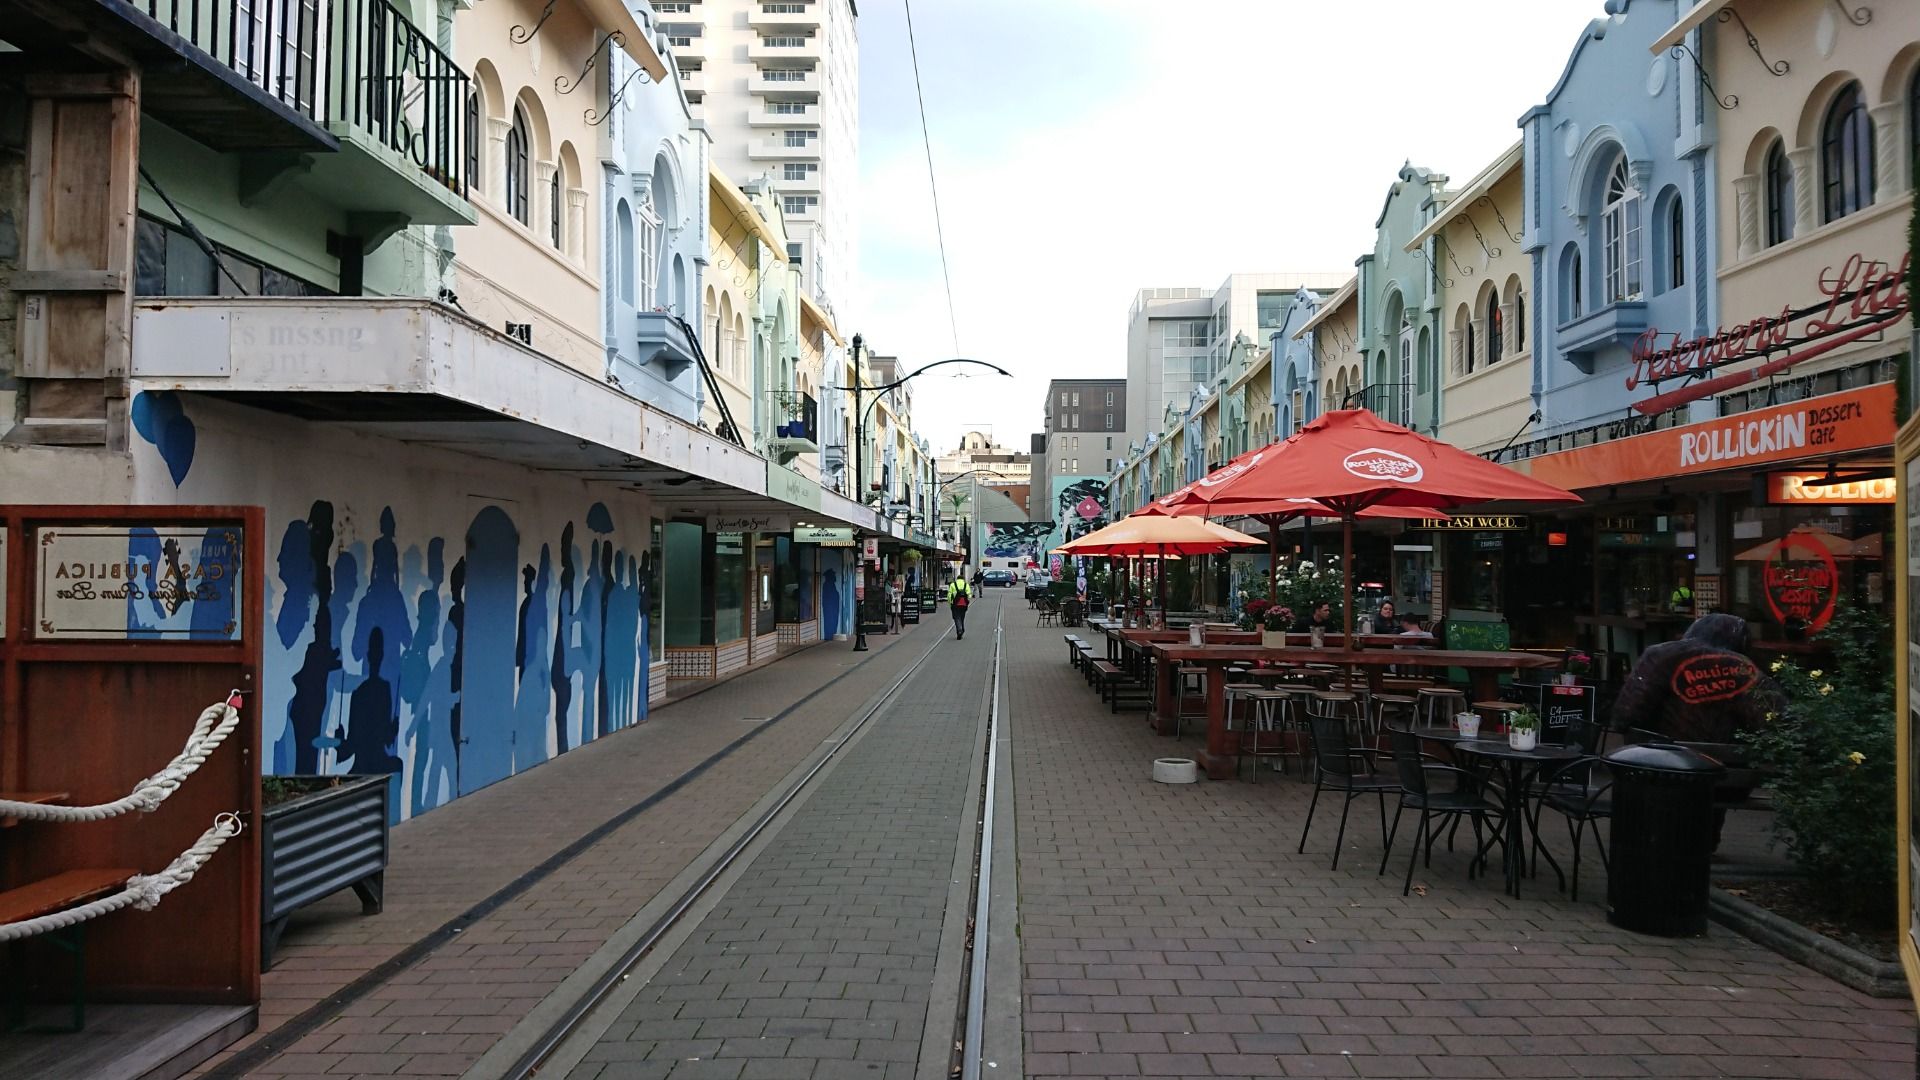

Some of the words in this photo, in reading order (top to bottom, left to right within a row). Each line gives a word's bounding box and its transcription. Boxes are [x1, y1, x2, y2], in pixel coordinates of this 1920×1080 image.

[1626, 304, 1790, 391] Petersens
[1805, 252, 1910, 338] Ltd
[1685, 680, 1736, 698] GELATO
